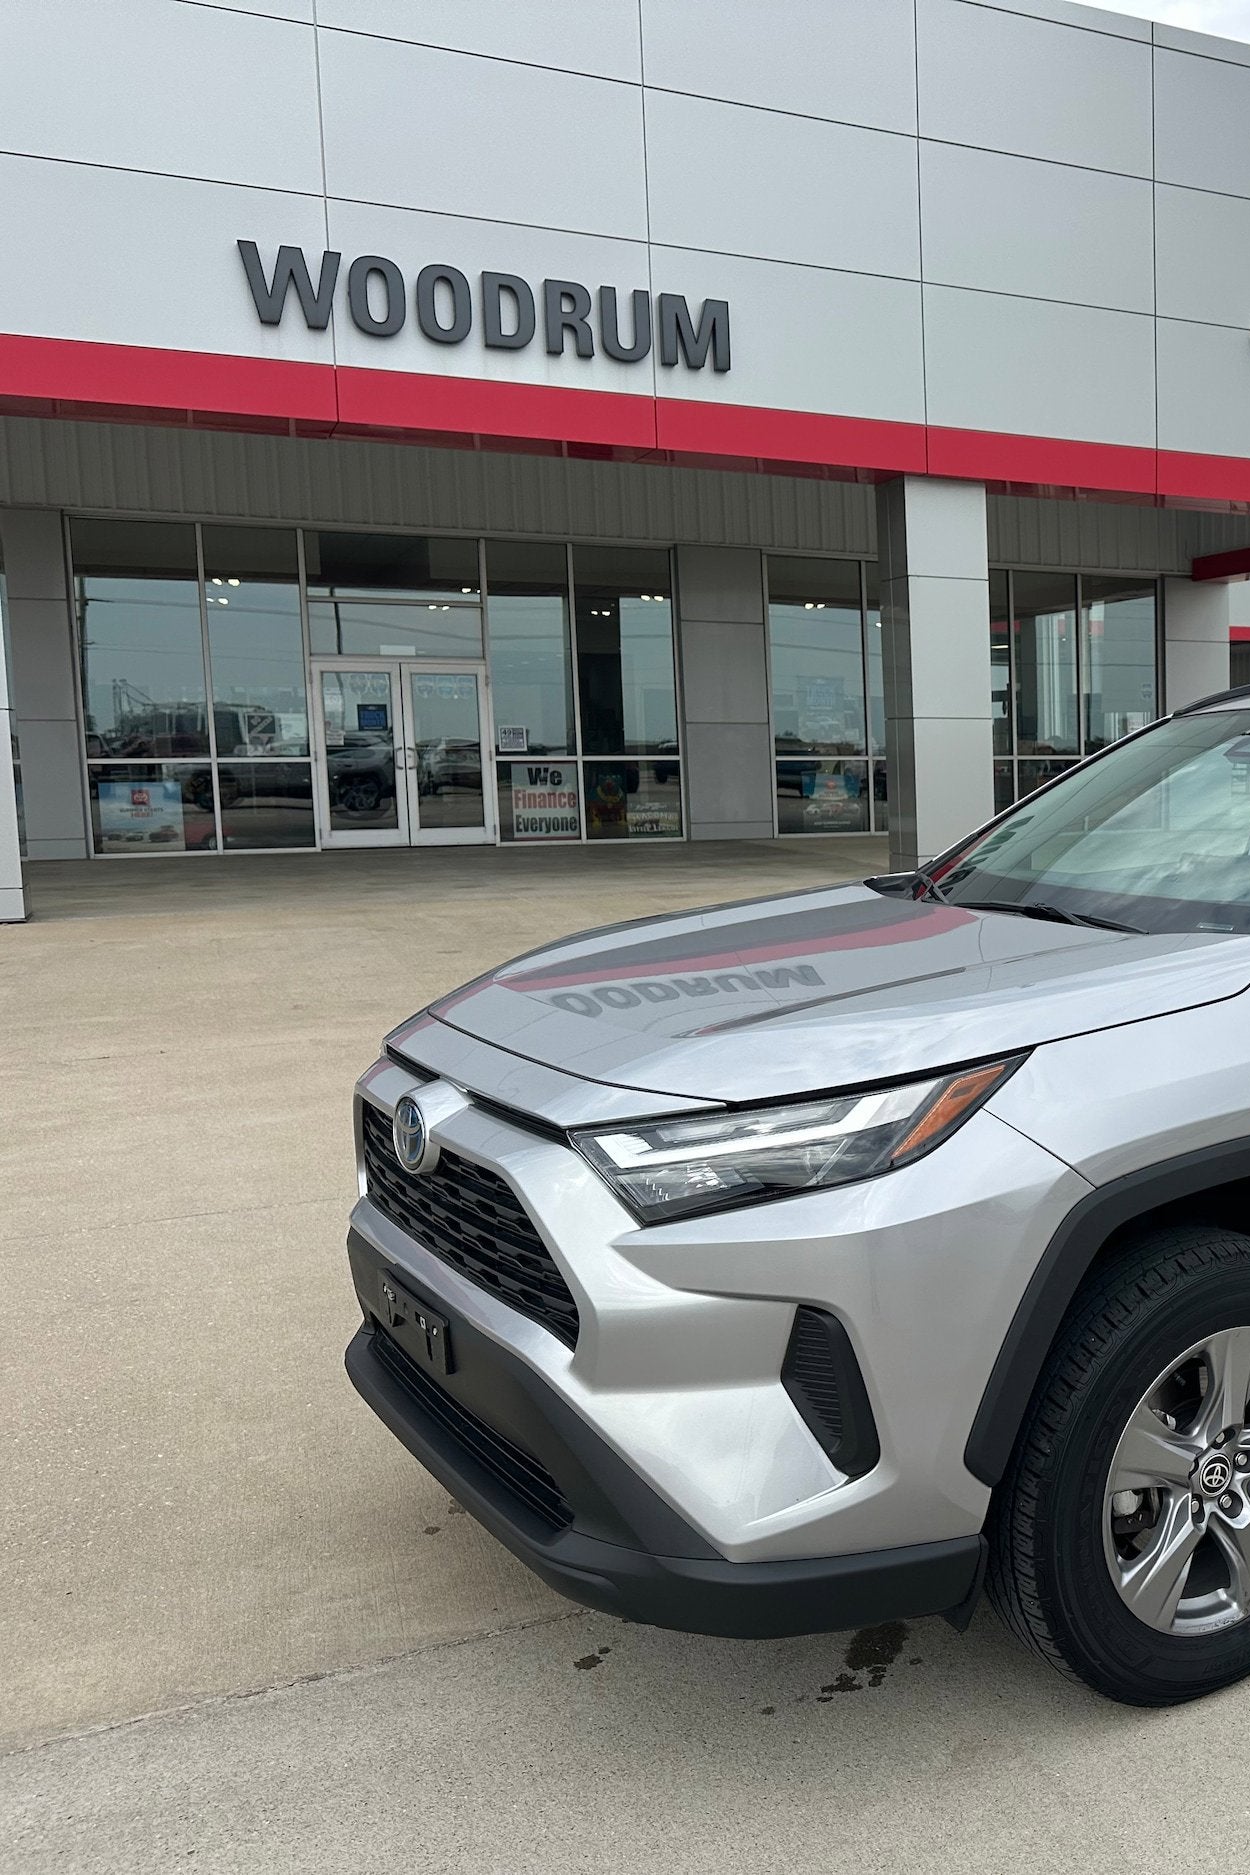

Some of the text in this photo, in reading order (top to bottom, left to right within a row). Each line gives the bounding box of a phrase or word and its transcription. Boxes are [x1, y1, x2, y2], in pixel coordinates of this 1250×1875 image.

[236, 240, 731, 373] WOODRUM
[527, 767, 563, 786] We
[513, 788, 577, 809] Finance
[515, 814, 578, 834] Everyone
